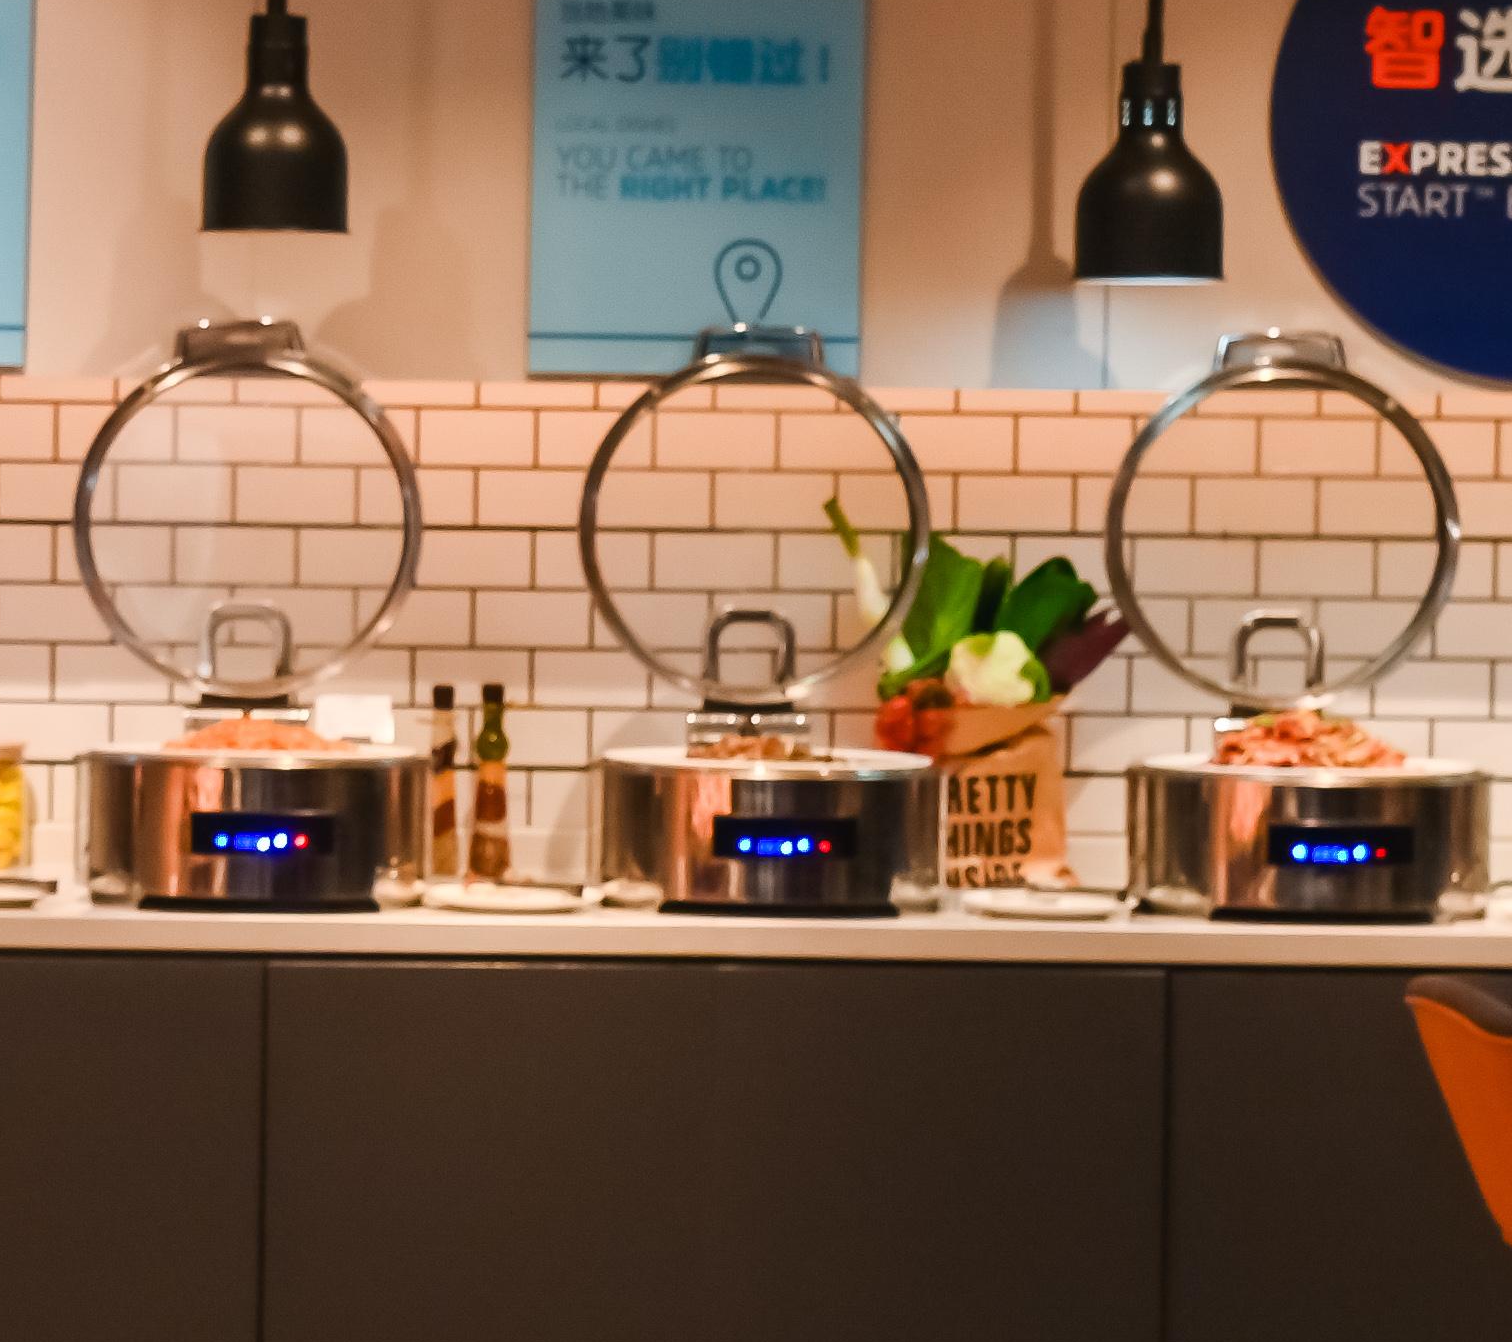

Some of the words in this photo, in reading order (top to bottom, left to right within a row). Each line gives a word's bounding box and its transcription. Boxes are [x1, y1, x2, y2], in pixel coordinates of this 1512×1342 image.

[557, 145, 617, 171] YOU
[626, 145, 702, 171] CAME
[717, 146, 753, 172] TO
[948, 774, 1037, 814] RETTY
